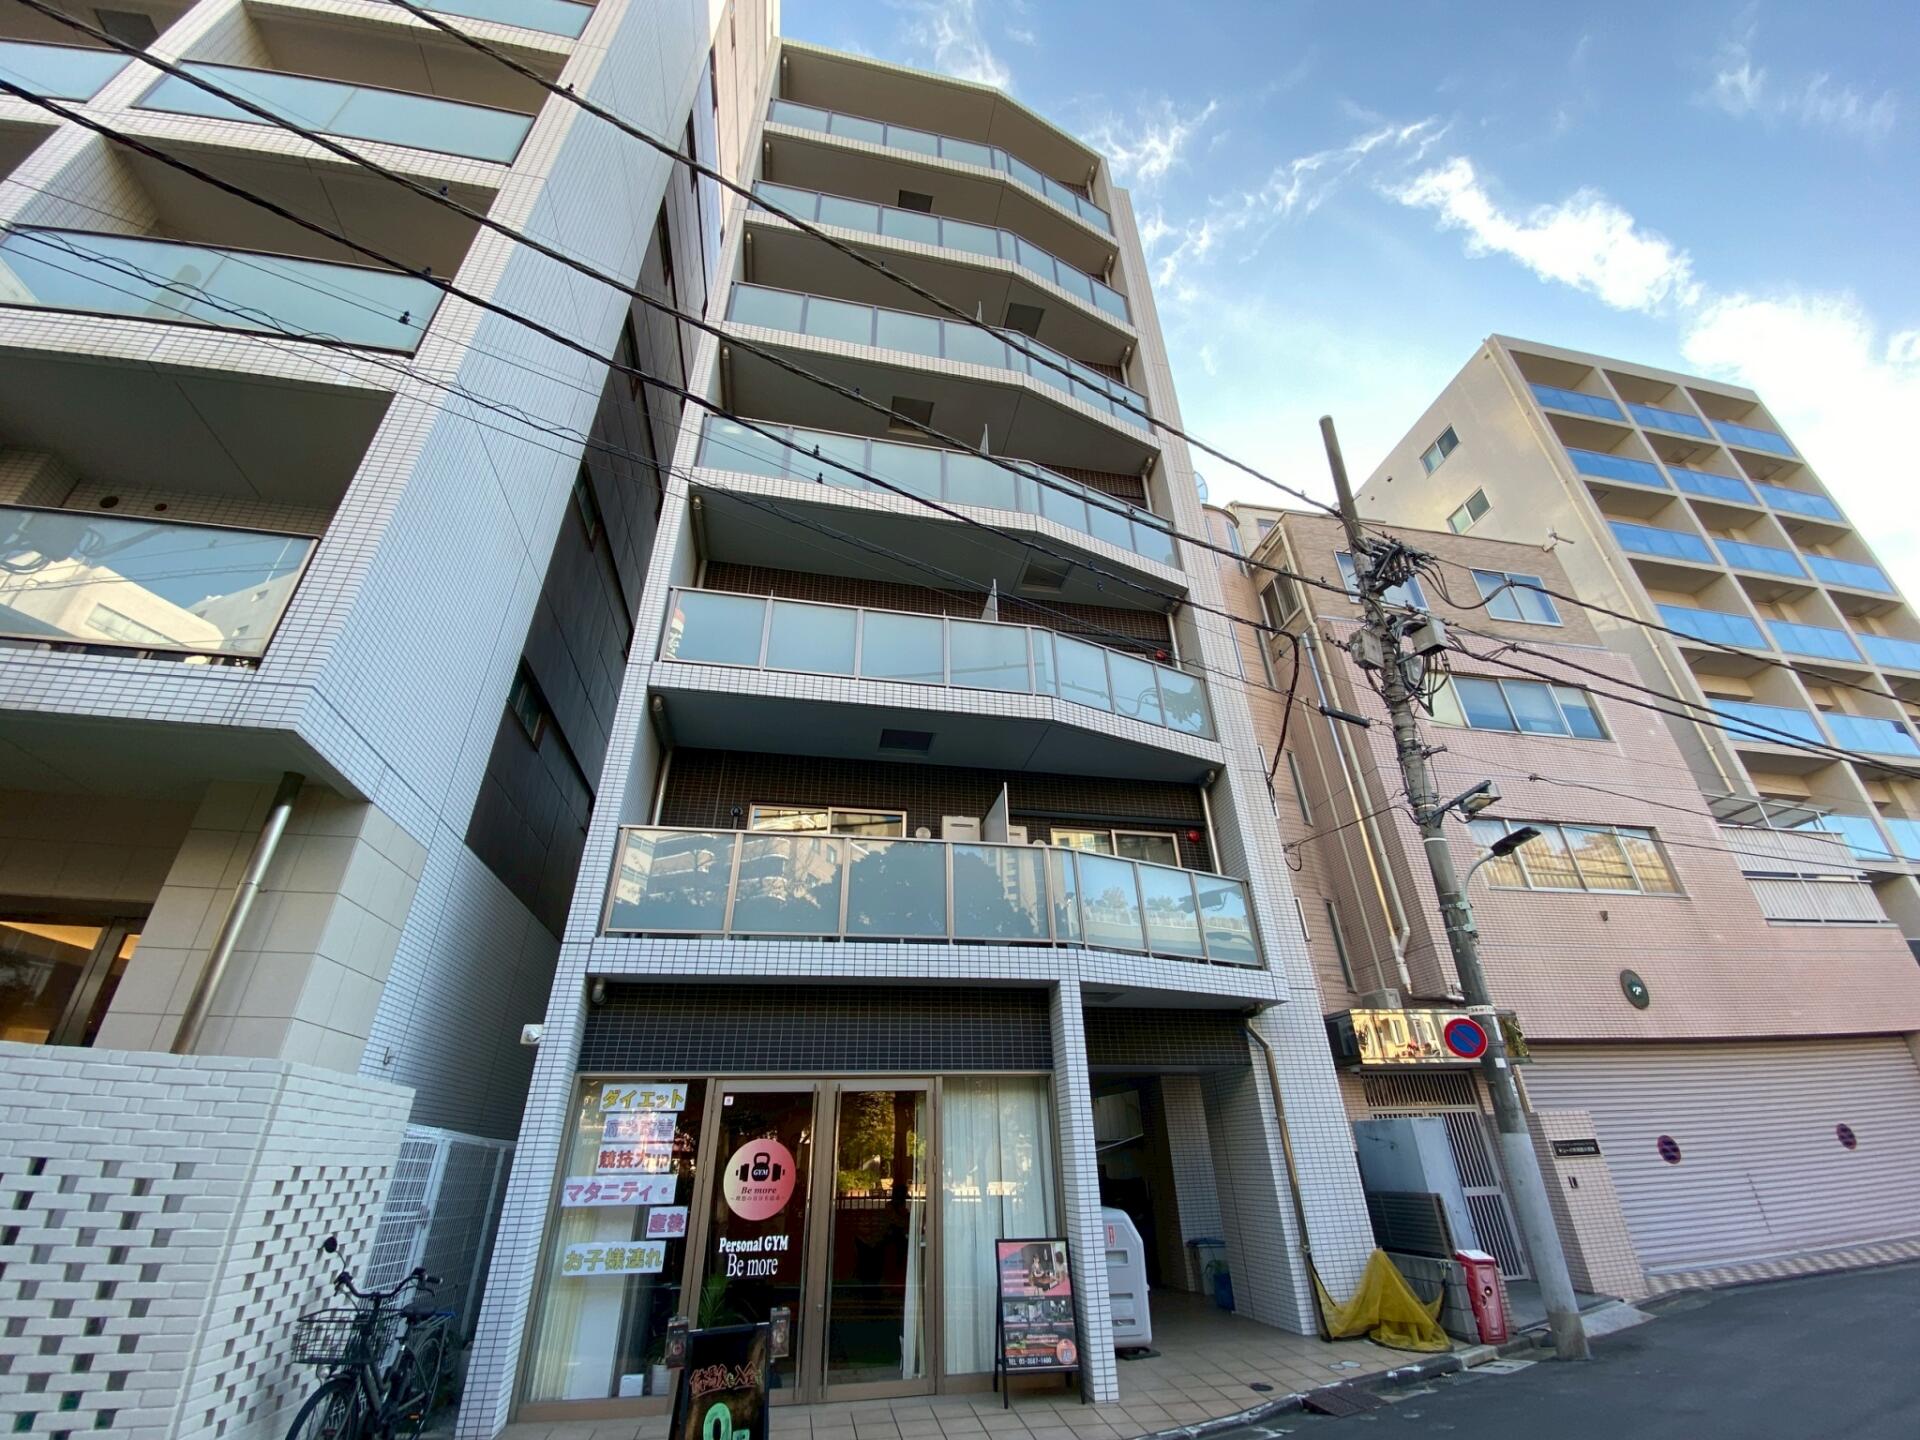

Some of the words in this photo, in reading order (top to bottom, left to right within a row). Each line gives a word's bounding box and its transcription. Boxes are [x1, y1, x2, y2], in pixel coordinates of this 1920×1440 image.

[602, 1088, 684, 1109] ダイエット
[648, 1213, 684, 1233] 産後
[719, 1236, 763, 1253] Personal
[764, 1235, 789, 1251] GYM
[563, 1247, 663, 1271] お子様連れ
[726, 1253, 744, 1277] Be
[747, 1258, 778, 1276] more
